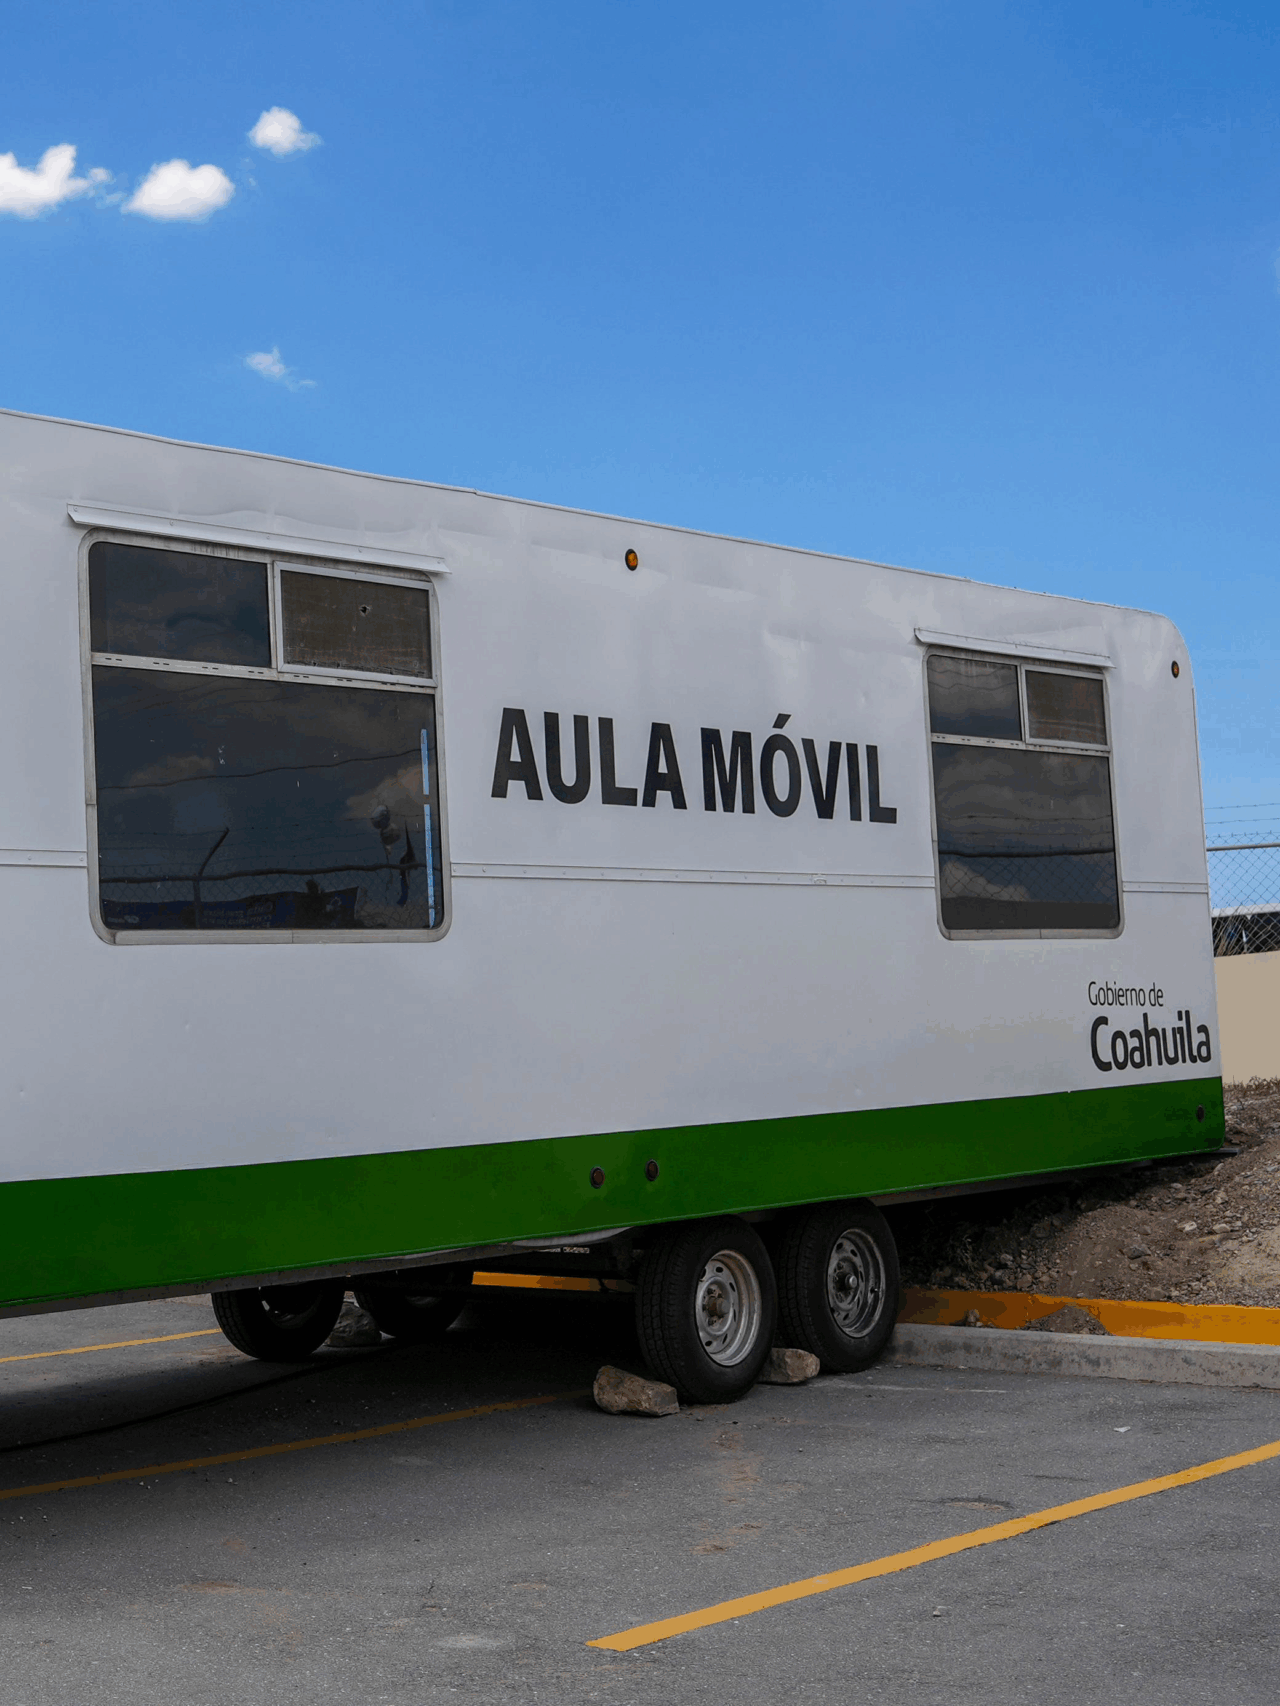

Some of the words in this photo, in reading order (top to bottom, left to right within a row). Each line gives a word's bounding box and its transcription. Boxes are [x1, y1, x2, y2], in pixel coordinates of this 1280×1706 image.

[491, 707, 687, 811] AULA
[700, 713, 898, 824] MÓVIL
[1088, 981, 1146, 1006] Gobierno
[1149, 982, 1164, 1007] de
[1090, 1010, 1212, 1072] Coahuila
